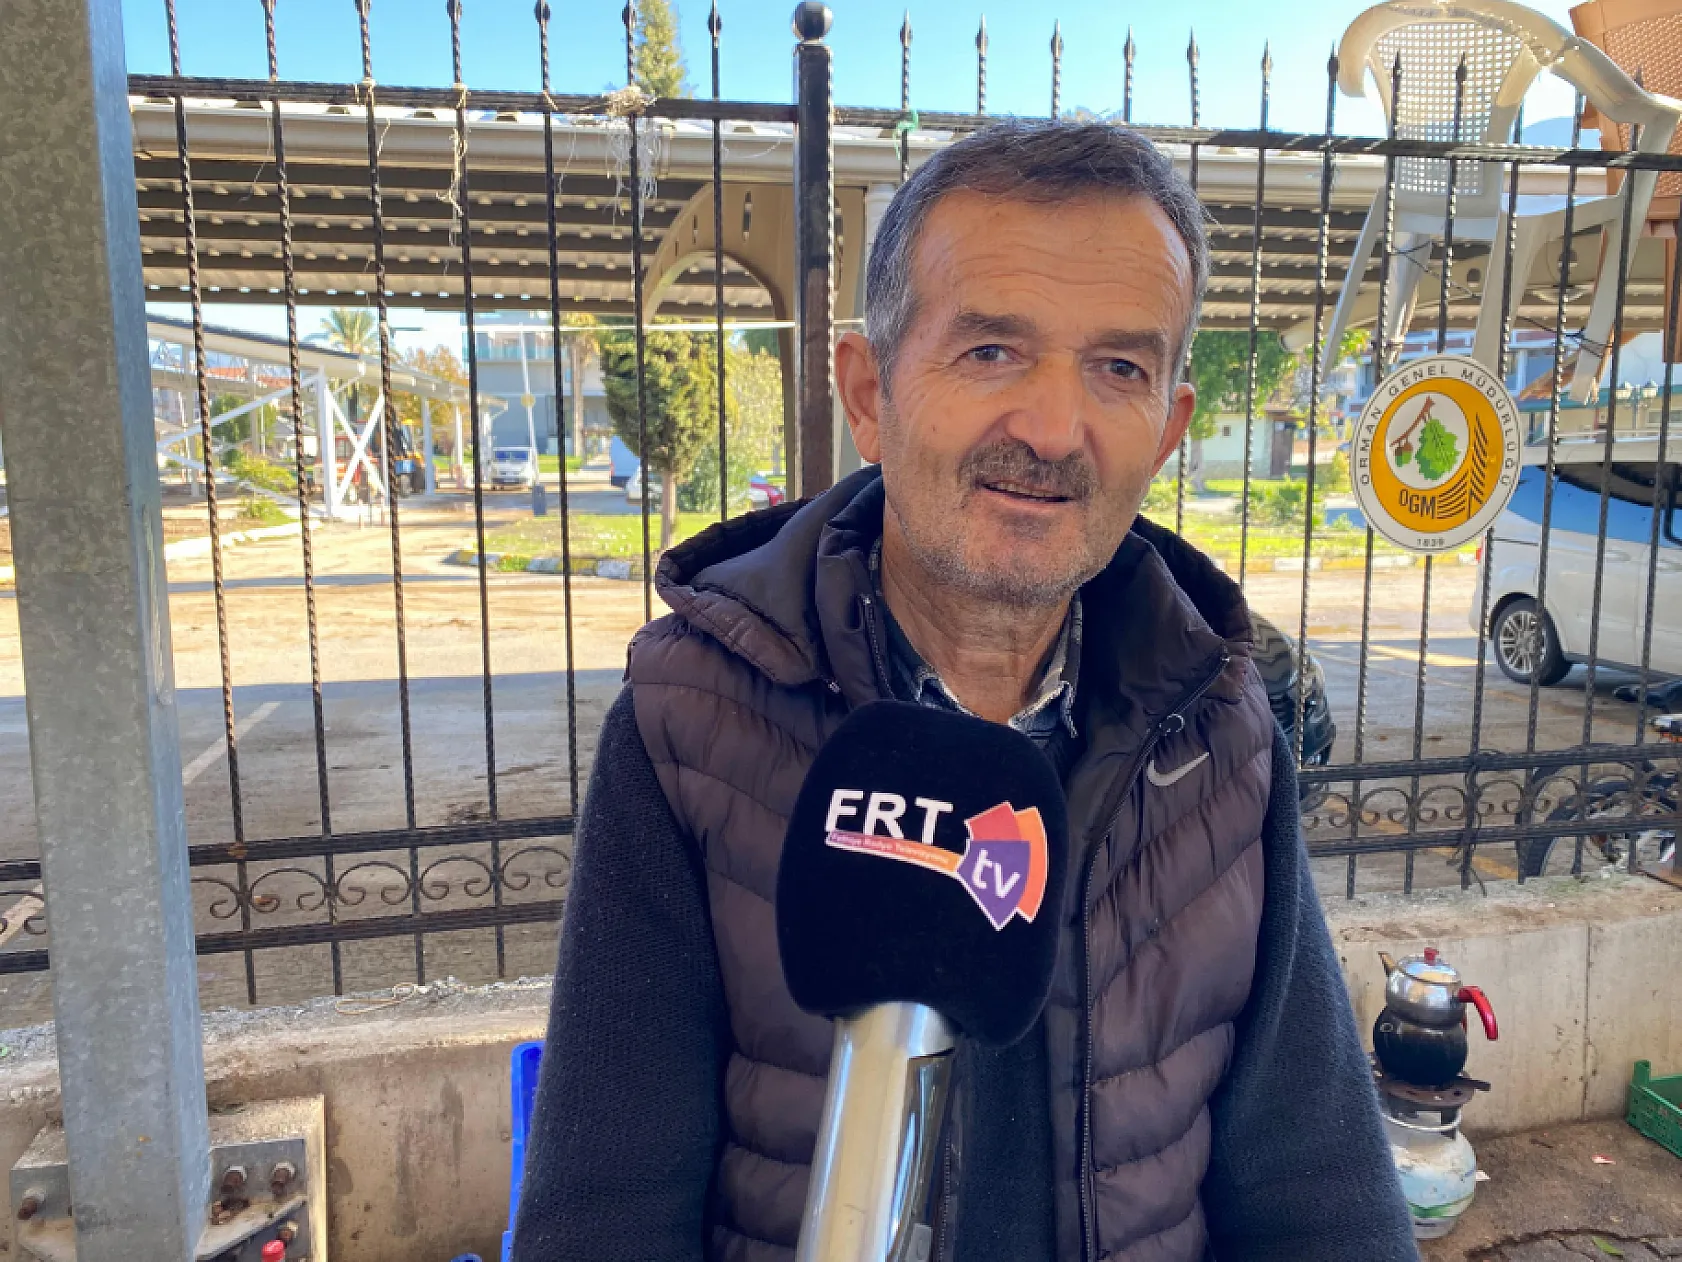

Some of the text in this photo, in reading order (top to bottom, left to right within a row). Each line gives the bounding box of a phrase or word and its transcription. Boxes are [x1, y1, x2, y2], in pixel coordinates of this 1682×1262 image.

[1360, 407, 1382, 485] ORMAN
[1389, 365, 1448, 396] GENEL
[1399, 489, 1436, 519] OGM
[825, 788, 953, 845] FRT
[972, 848, 1020, 898] tv
